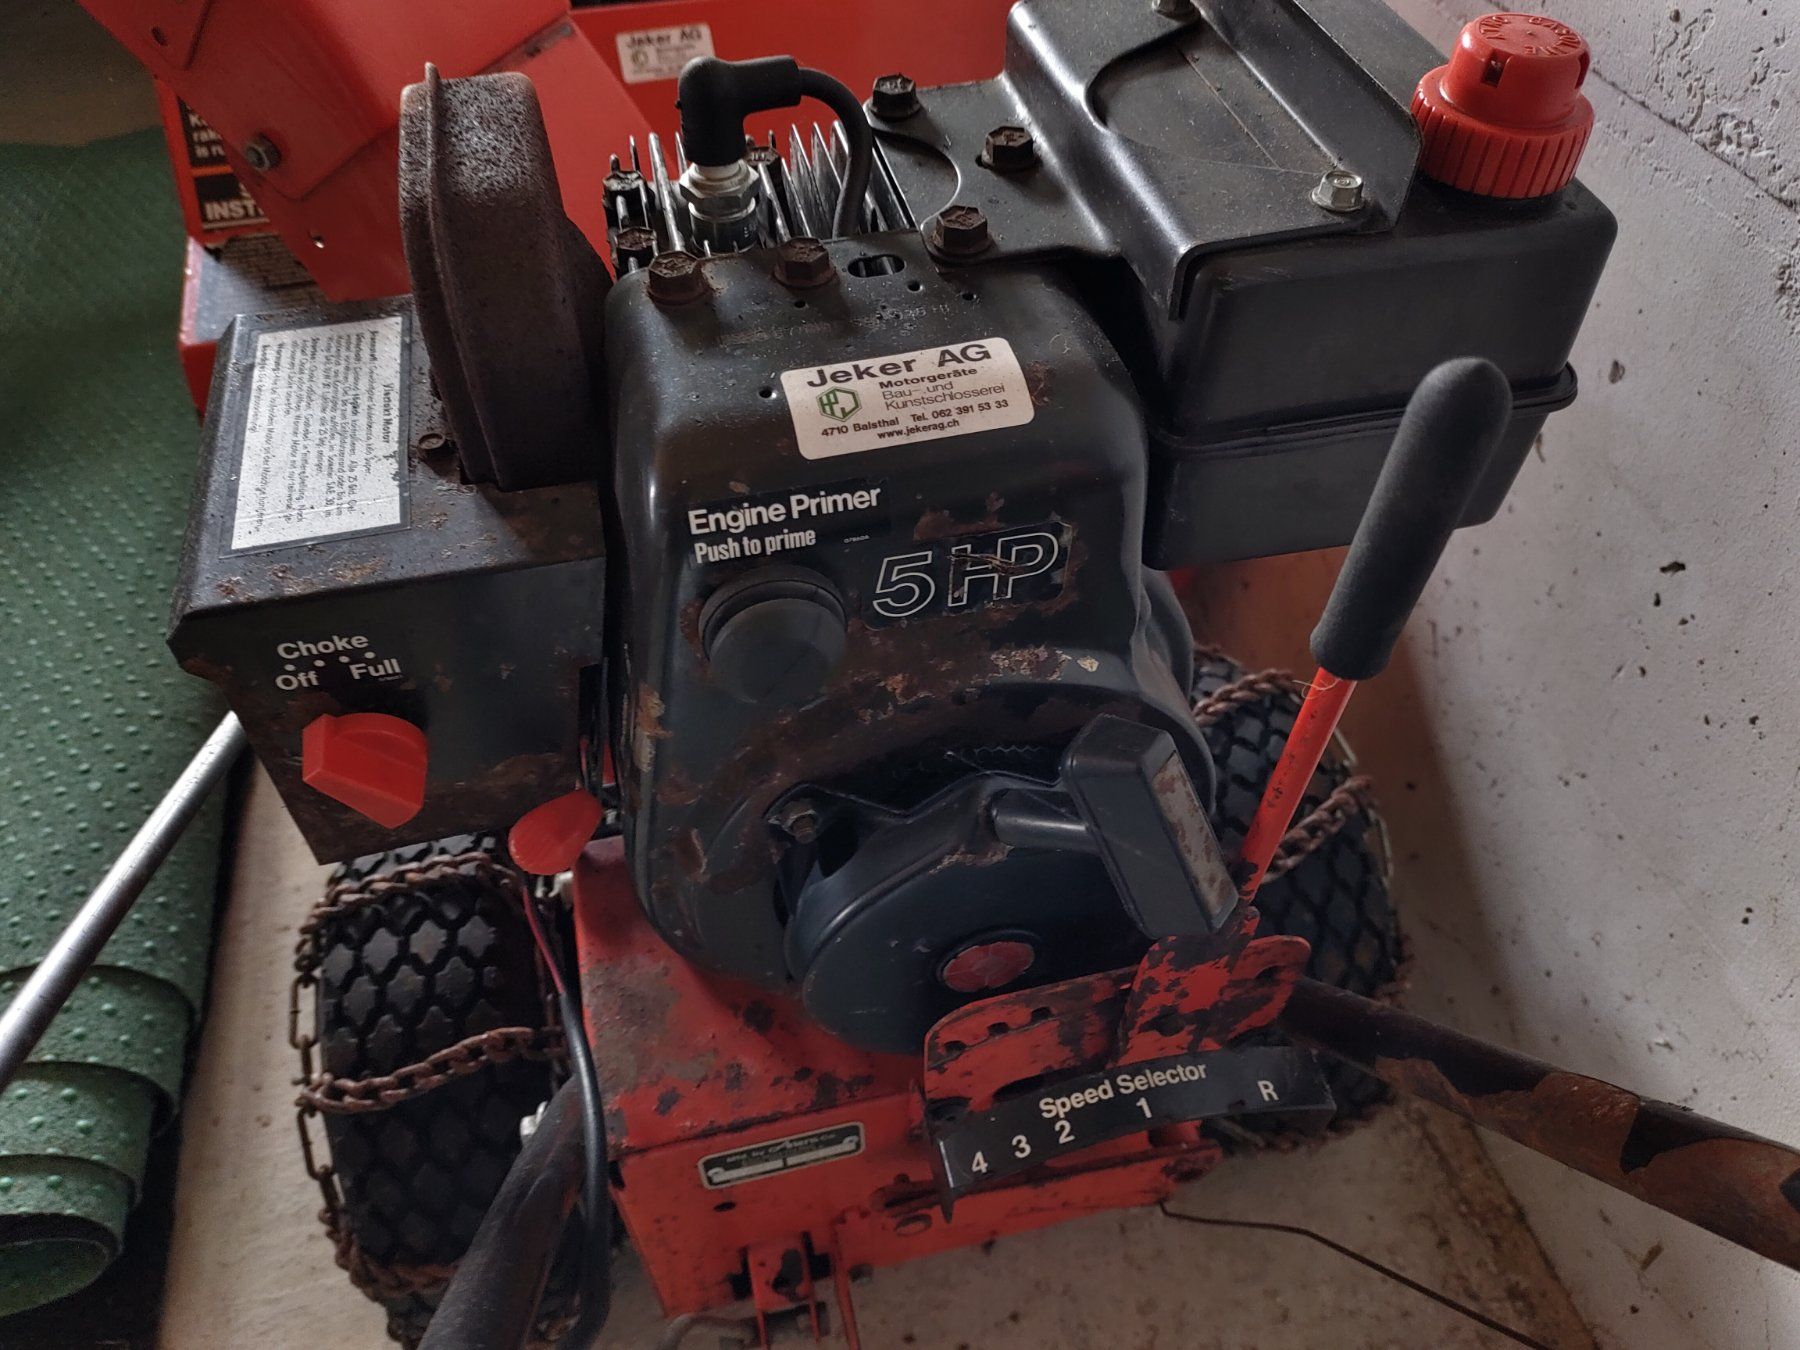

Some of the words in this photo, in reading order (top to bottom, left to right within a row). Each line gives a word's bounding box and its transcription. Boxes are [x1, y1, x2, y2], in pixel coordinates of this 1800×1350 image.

[205, 199, 265, 221] INST
[807, 358, 917, 388] Jeker
[937, 343, 992, 368] AG
[878, 367, 978, 390] Motorgeräte
[885, 384, 1006, 411] Kunstschlosserei
[923, 381, 954, 394] und
[821, 425, 849, 438] 4710
[853, 416, 900, 433] Balsthal
[931, 409, 952, 420] 062
[956, 405, 975, 416] 391
[977, 402, 992, 413] 53
[994, 399, 1009, 410] 33
[877, 417, 960, 440] www.jekerag.ch
[687, 501, 787, 535] Engine
[790, 486, 881, 520] Primer
[694, 537, 741, 564] Push
[742, 535, 762, 556] to
[765, 528, 817, 556] prime
[872, 550, 936, 618] 5
[946, 531, 1060, 609] HP
[277, 635, 369, 659] Choke
[275, 670, 320, 691] Off
[349, 658, 401, 680] Full
[1039, 1079, 1114, 1120] Speed
[1115, 1062, 1207, 1096] Selector
[971, 1151, 989, 1175] 4
[1011, 1135, 1032, 1159] 3
[1054, 1120, 1076, 1145] 2
[1136, 1097, 1153, 1119] 1
[1256, 1080, 1280, 1102] R
